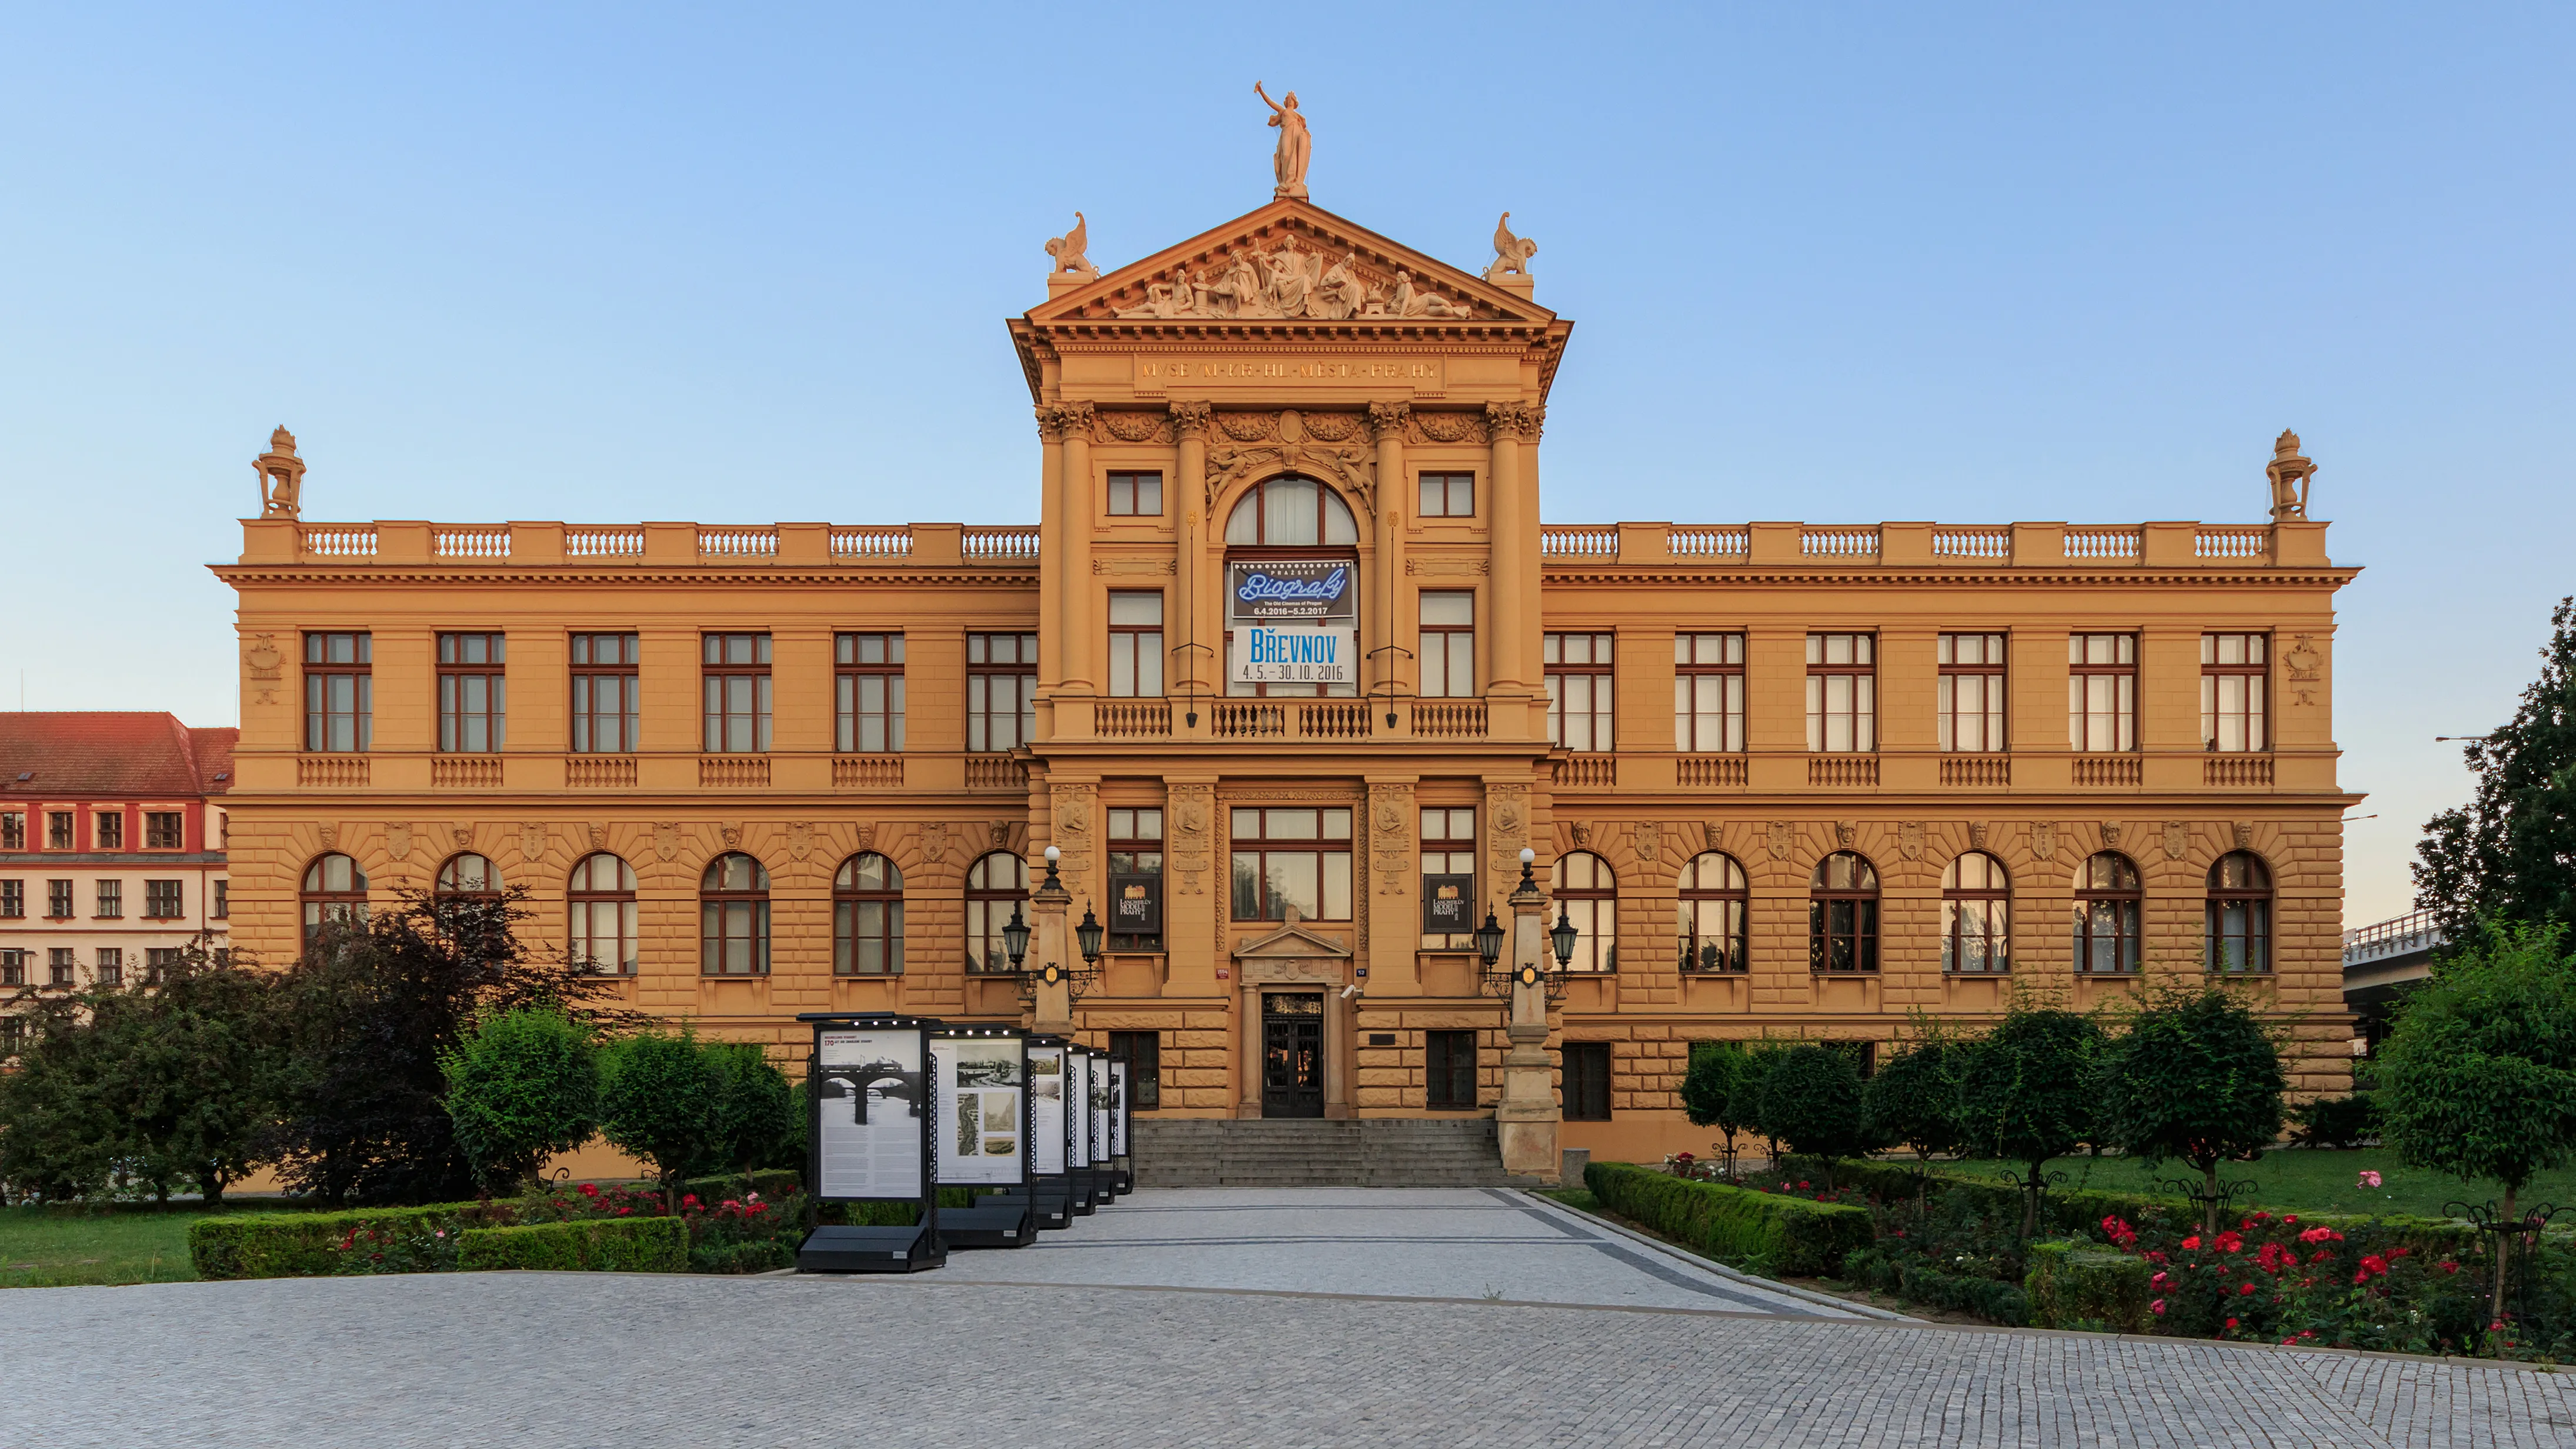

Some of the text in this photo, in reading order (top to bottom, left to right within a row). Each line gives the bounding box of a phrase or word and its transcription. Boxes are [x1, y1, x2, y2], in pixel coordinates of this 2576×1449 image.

[1300, 360, 1360, 378] MĚSTA
[1239, 568, 1346, 600] Biografy
[1318, 666, 1343, 680] 2016
